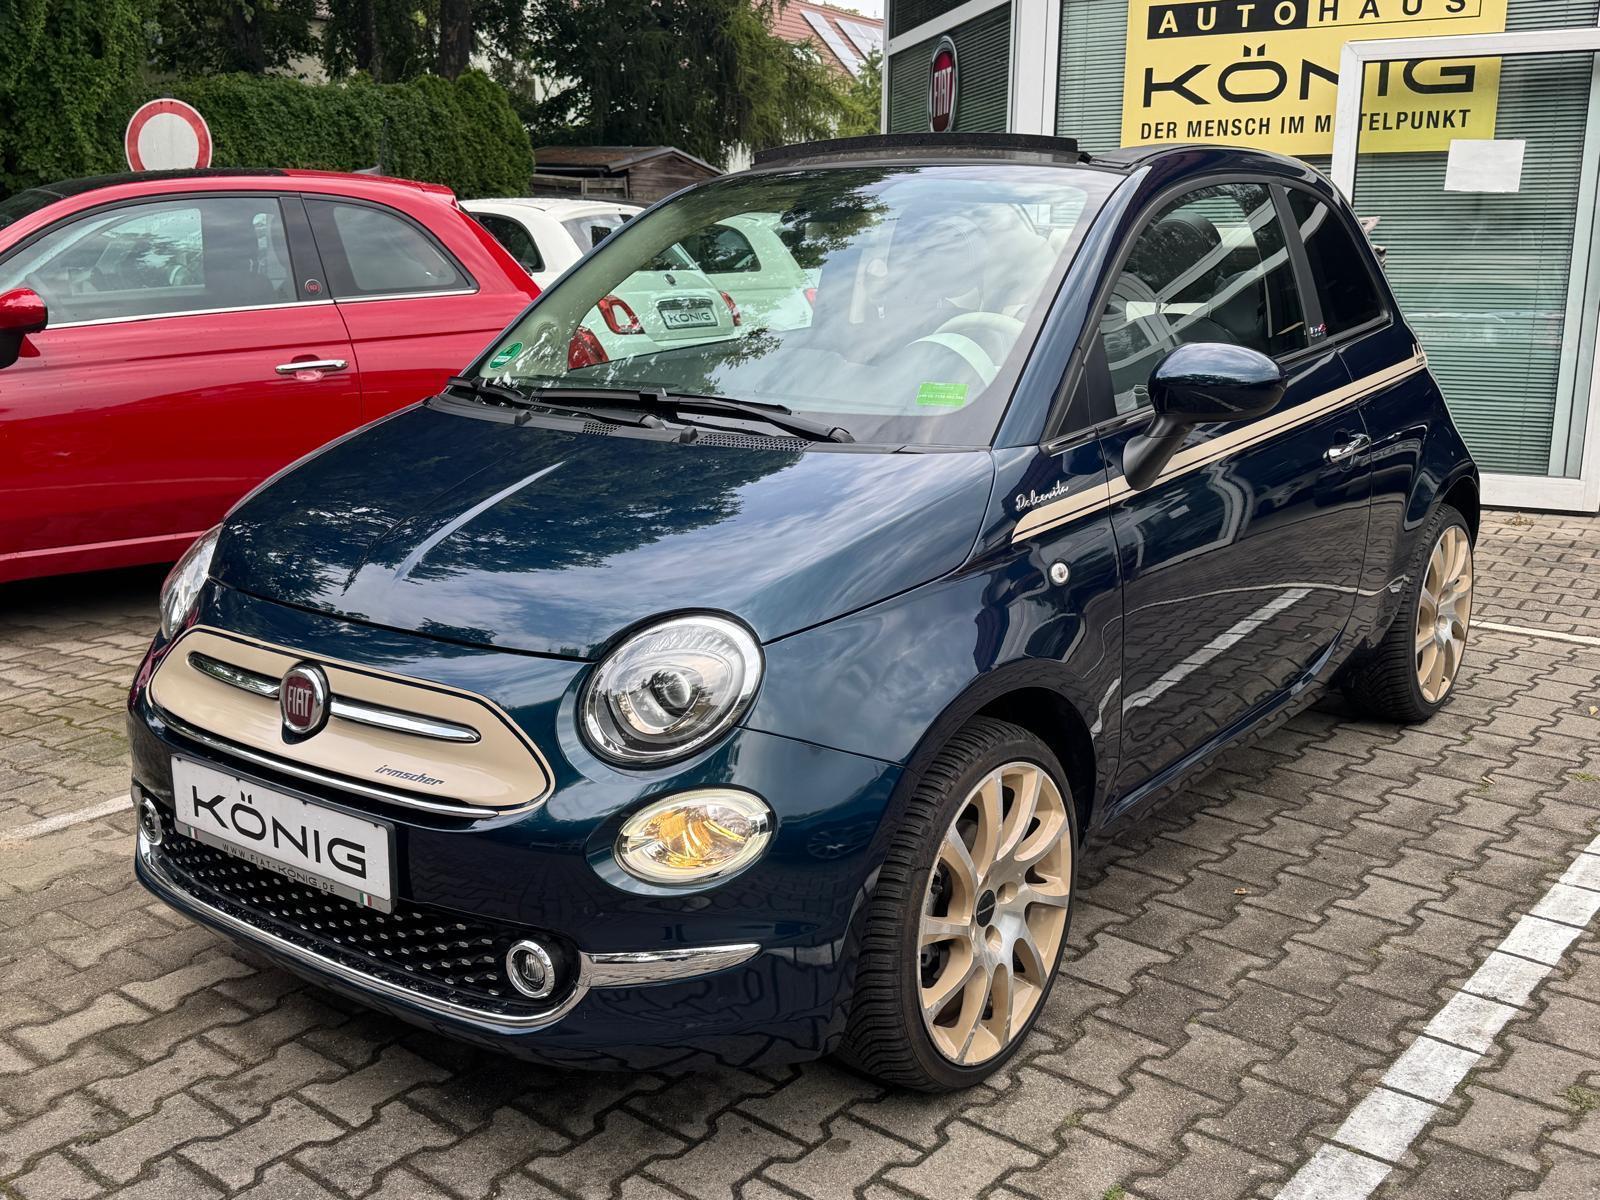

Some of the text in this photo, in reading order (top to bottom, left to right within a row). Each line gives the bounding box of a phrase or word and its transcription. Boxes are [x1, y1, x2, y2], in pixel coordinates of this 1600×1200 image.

[932, 65, 952, 118] FIAT
[1142, 43, 1476, 108] KÖNIG
[1140, 108, 1472, 140] DER MENSCH IM MTELPUNKT
[287, 685, 313, 718] FIAT
[374, 764, 446, 786] irmscher
[191, 784, 367, 880] KÖNIG
